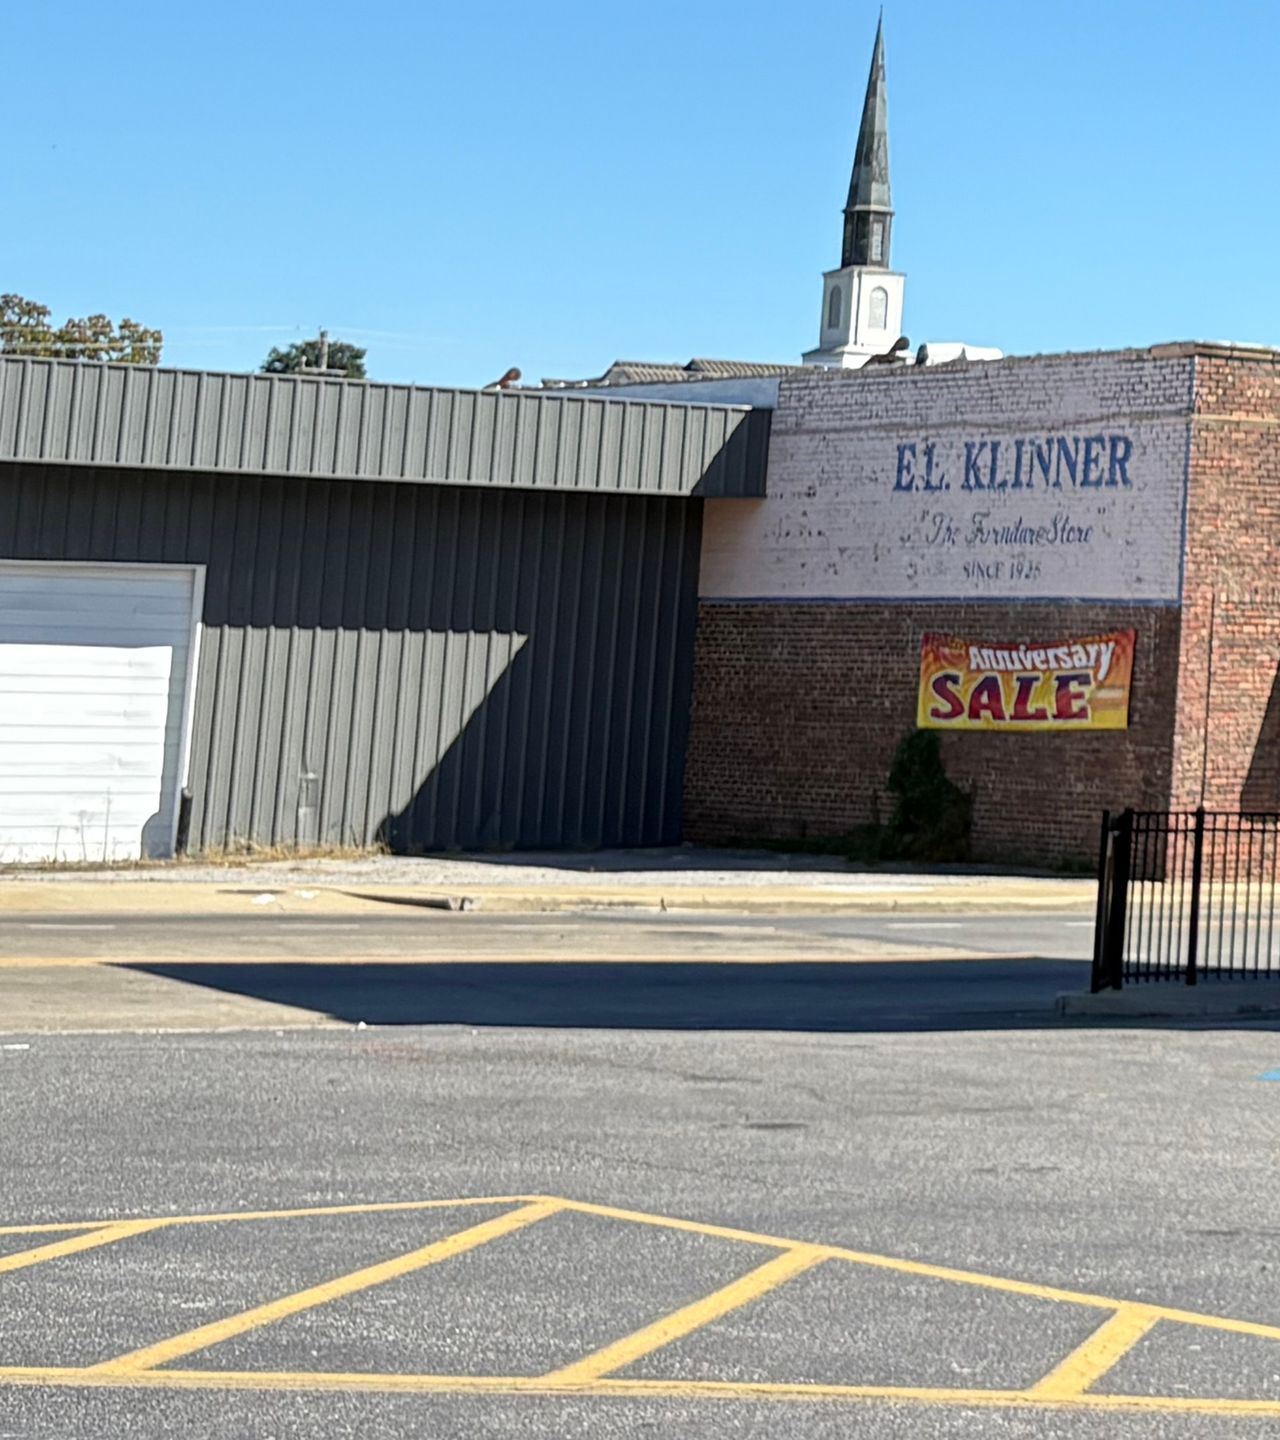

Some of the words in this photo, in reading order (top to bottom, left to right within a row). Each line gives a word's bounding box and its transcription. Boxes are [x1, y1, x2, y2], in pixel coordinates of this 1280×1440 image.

[893, 441, 950, 492] E.L.
[961, 435, 1133, 492] KLINNER
[968, 642, 1115, 681] Anniversary
[930, 672, 1092, 721] SALE
